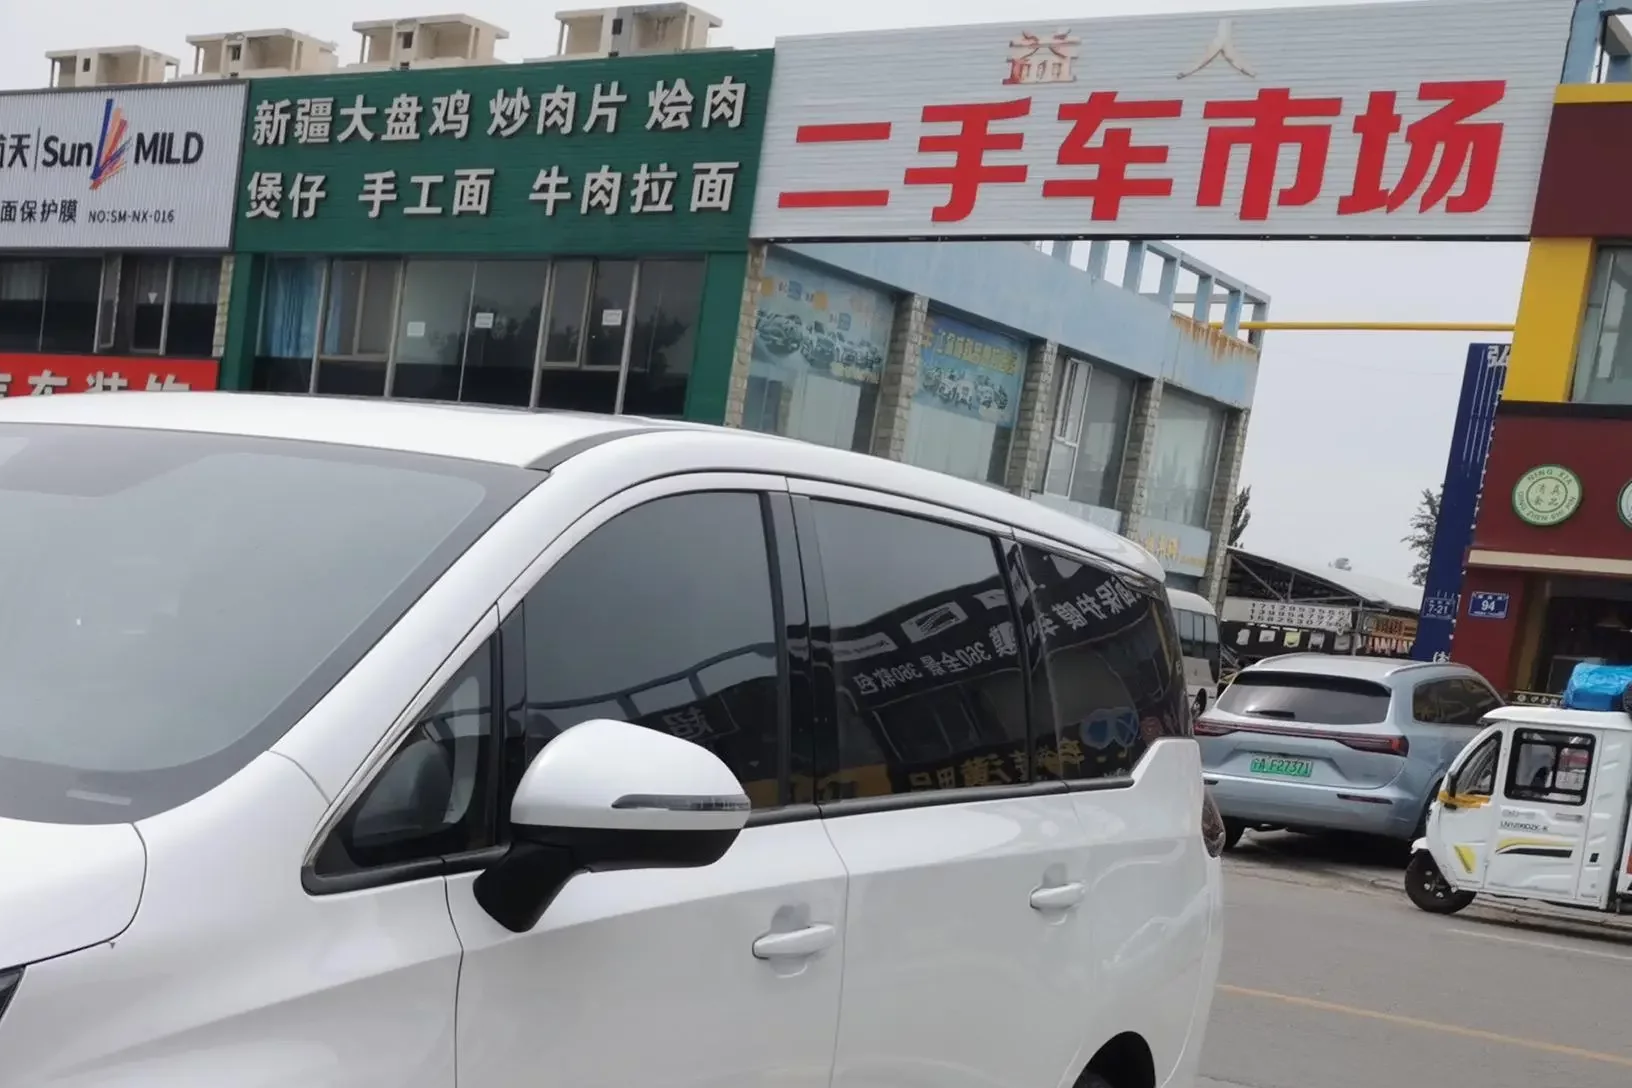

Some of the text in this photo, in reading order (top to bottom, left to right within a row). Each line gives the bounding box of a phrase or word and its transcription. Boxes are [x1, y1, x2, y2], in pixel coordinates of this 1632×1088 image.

[253, 75, 748, 146] 新疆大盘鸡 炒肉片 烩肉
[42, 131, 204, 168] Sun MILD
[777, 80, 1507, 222] 二手车市场
[244, 160, 741, 219] 煲仔 手工面 牛肉拉面
[88, 208, 175, 224] NO:SM-NX-016
[1481, 600, 1497, 612] 94
